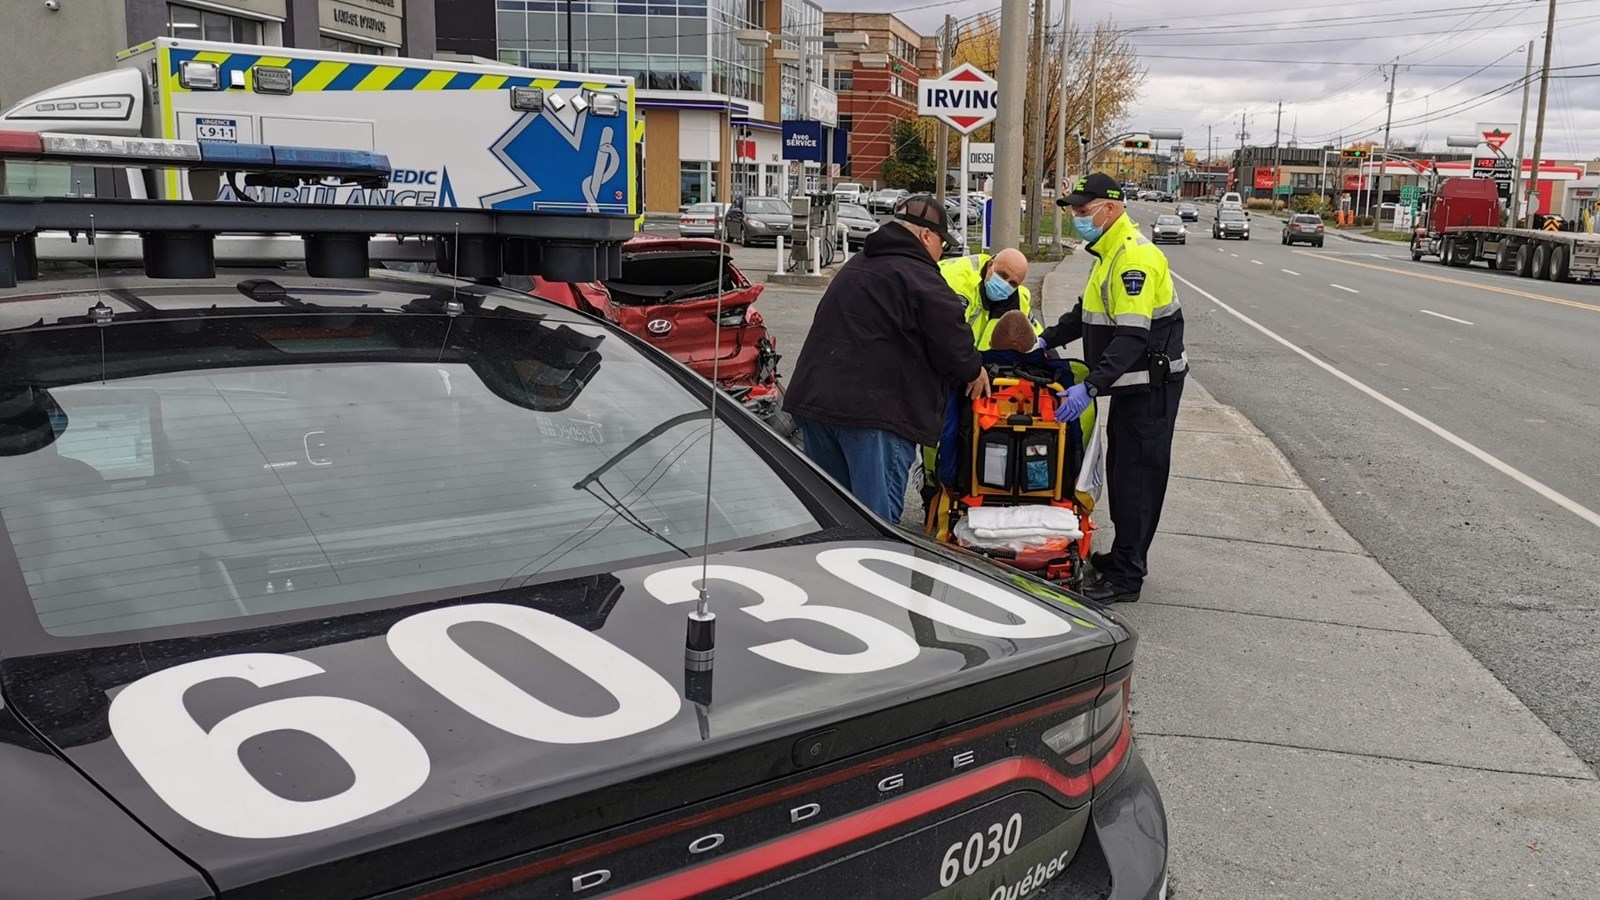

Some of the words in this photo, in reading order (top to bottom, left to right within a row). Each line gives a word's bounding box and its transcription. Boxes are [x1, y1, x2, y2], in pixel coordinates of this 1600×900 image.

[786, 139, 817, 147] SERVICE
[970, 152, 994, 164] DIESEL
[388, 169, 438, 185] EDIC
[108, 547, 1072, 839] 6030
[939, 812, 1023, 888] 6030
